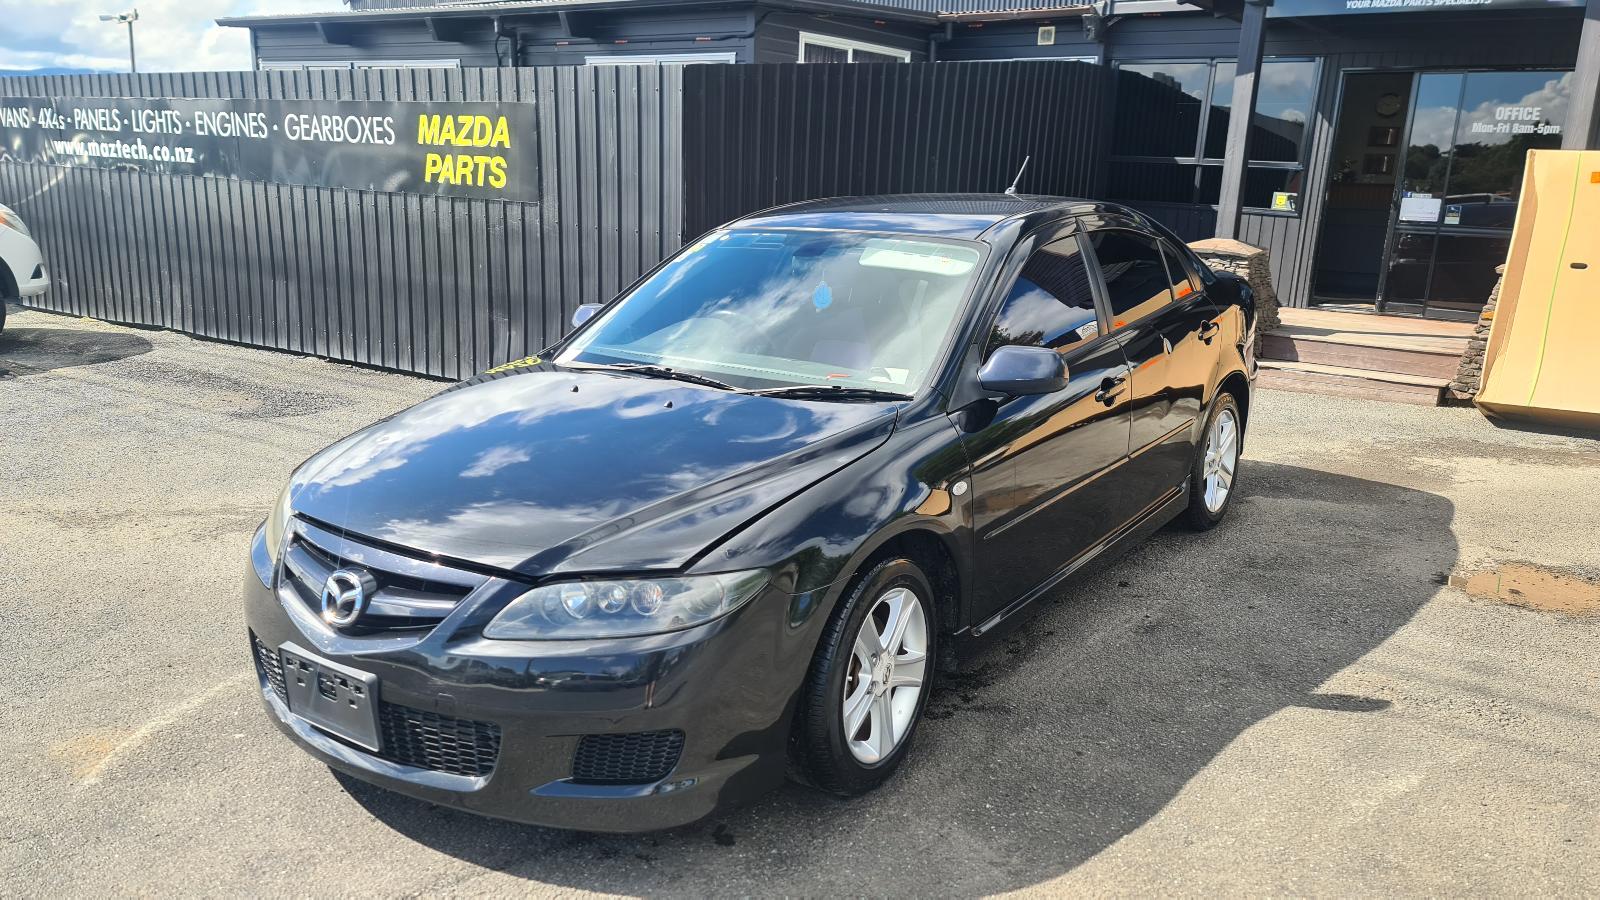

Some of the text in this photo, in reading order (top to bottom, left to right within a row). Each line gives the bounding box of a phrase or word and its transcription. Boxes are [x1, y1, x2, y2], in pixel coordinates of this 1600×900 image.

[1346, 0, 1370, 9] YOUR
[1371, 0, 1401, 8] MAZDA
[0, 107, 30, 129] VANS
[74, 108, 121, 132] PANELS
[131, 109, 182, 135] LIGHTS
[194, 111, 268, 139] ENGINES
[284, 113, 396, 146] GEARBOXES
[1495, 106, 1542, 121] OFFICE
[417, 114, 511, 149] MAZDA
[1472, 122, 1561, 136] Mon-Fri 8am-5pm
[53, 137, 196, 163] www.maztech.co.nz
[424, 153, 508, 189] PARTS
